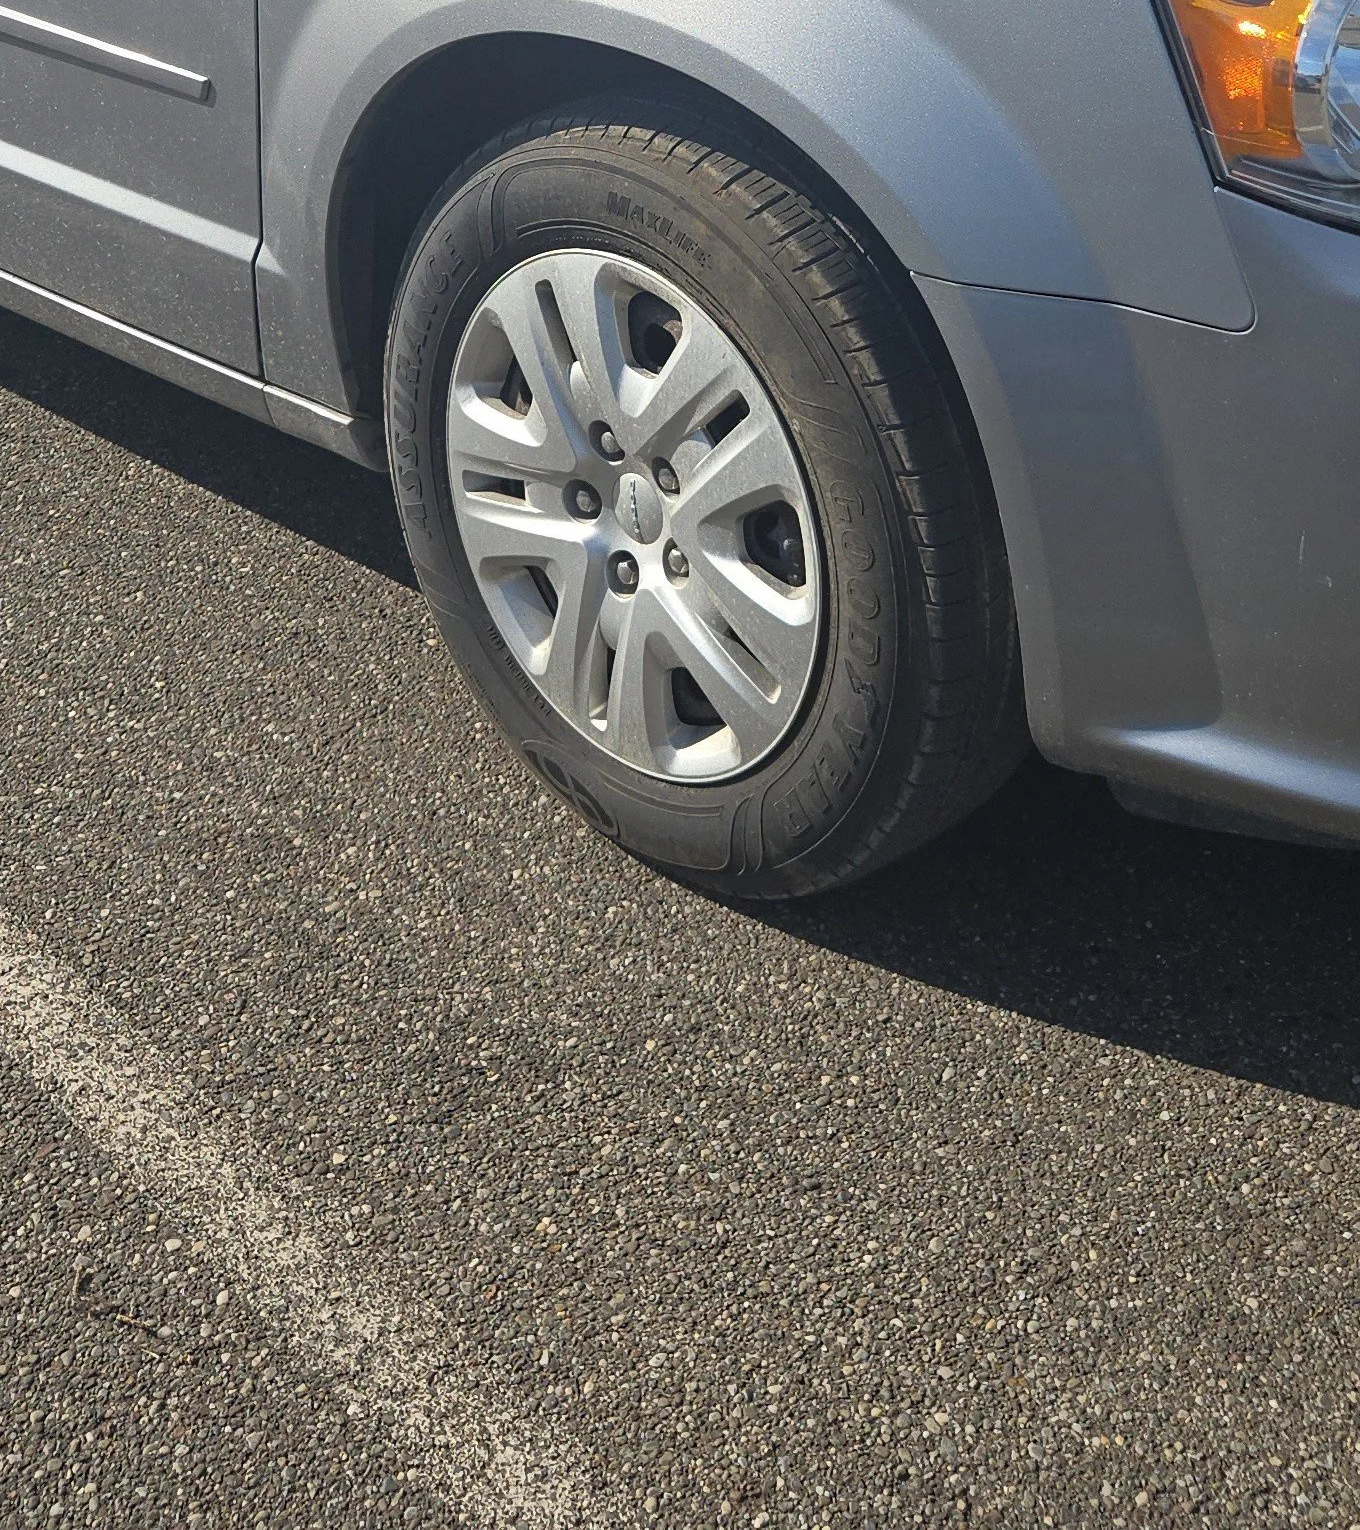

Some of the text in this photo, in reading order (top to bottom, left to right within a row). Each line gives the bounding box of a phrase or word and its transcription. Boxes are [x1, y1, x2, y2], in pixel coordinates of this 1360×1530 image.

[393, 228, 466, 540] ASSURANCE
[605, 191, 714, 271] MAXLIFE
[772, 479, 882, 838] GOODYEAR
